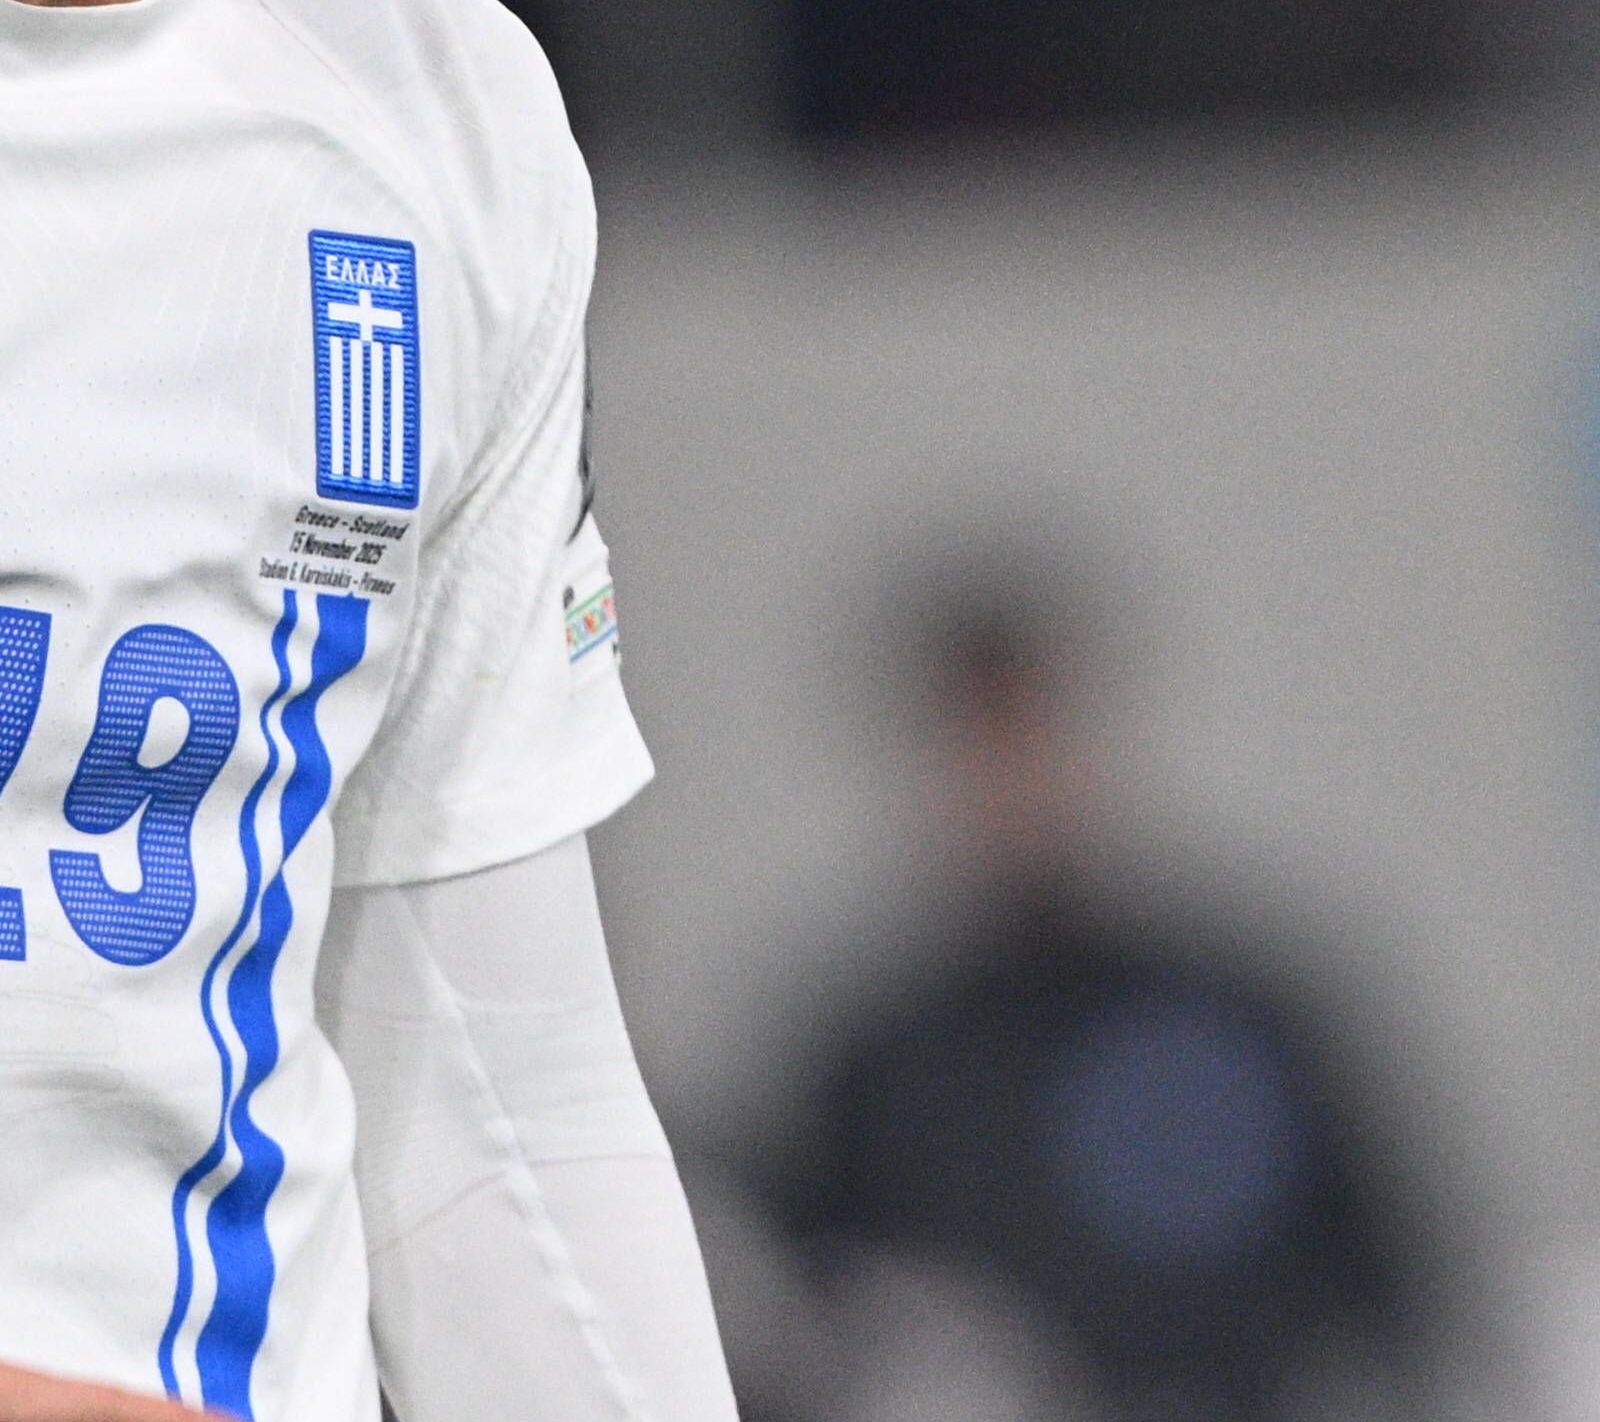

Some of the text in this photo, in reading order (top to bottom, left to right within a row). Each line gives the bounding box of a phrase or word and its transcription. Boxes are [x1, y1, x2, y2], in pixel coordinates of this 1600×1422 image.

[325, 254, 402, 289] ΕΛΛΑΣ
[294, 504, 340, 529] Greece
[349, 515, 411, 541] Scotland
[290, 531, 388, 565] 15 November 2025
